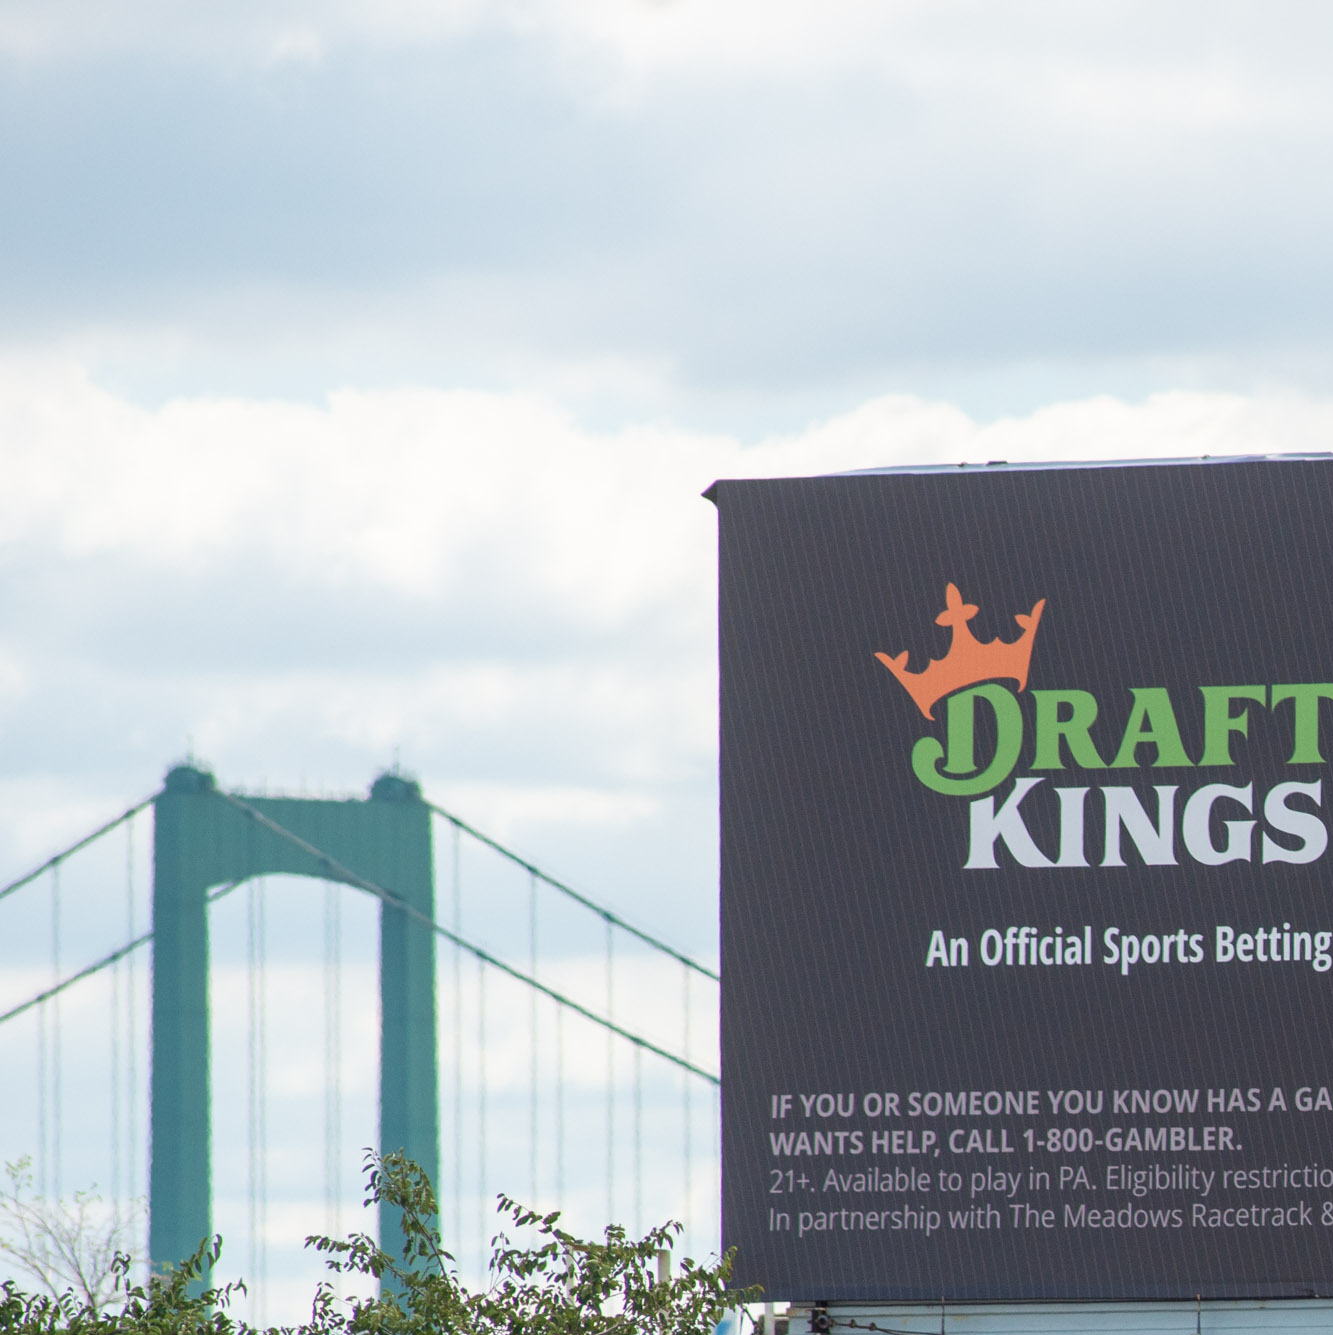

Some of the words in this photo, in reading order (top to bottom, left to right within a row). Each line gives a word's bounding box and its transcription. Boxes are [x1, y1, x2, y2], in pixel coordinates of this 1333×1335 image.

[961, 776, 1329, 870] KINGS
[925, 930, 969, 968] An
[980, 925, 1092, 967] Official
[1103, 926, 1205, 976] Sports
[1215, 922, 1333, 973] Betting
[771, 1094, 793, 1119] IF
[799, 1093, 855, 1118] YOU
[863, 1092, 901, 1118] OR
[907, 1090, 1040, 1117] SOMEONE
[1047, 1089, 1105, 1115] YOU
[1112, 1088, 1201, 1114] KNOW
[1206, 1087, 1262, 1113] HAS
[1268, 1086, 1288, 1112] A
[769, 1130, 864, 1156] WANTS
[871, 1129, 941, 1158] HELP,
[948, 1128, 1015, 1154] CALL
[1022, 1126, 1243, 1153] 1-800-GAMBLER.
[769, 1167, 816, 1194] 21+.
[822, 1165, 932, 1193] Available
[937, 1168, 964, 1192] to
[970, 1164, 1023, 1200] play
[1028, 1164, 1051, 1191] in
[1059, 1164, 1098, 1191] PA.
[1106, 1163, 1217, 1198] Eligibility
[769, 1206, 791, 1232] In
[798, 1204, 942, 1239] partnership
[948, 1203, 1002, 1230] with
[1008, 1202, 1056, 1229] The
[1063, 1201, 1184, 1229] Meadows
[1191, 1200, 1314, 1228] Racetrack
